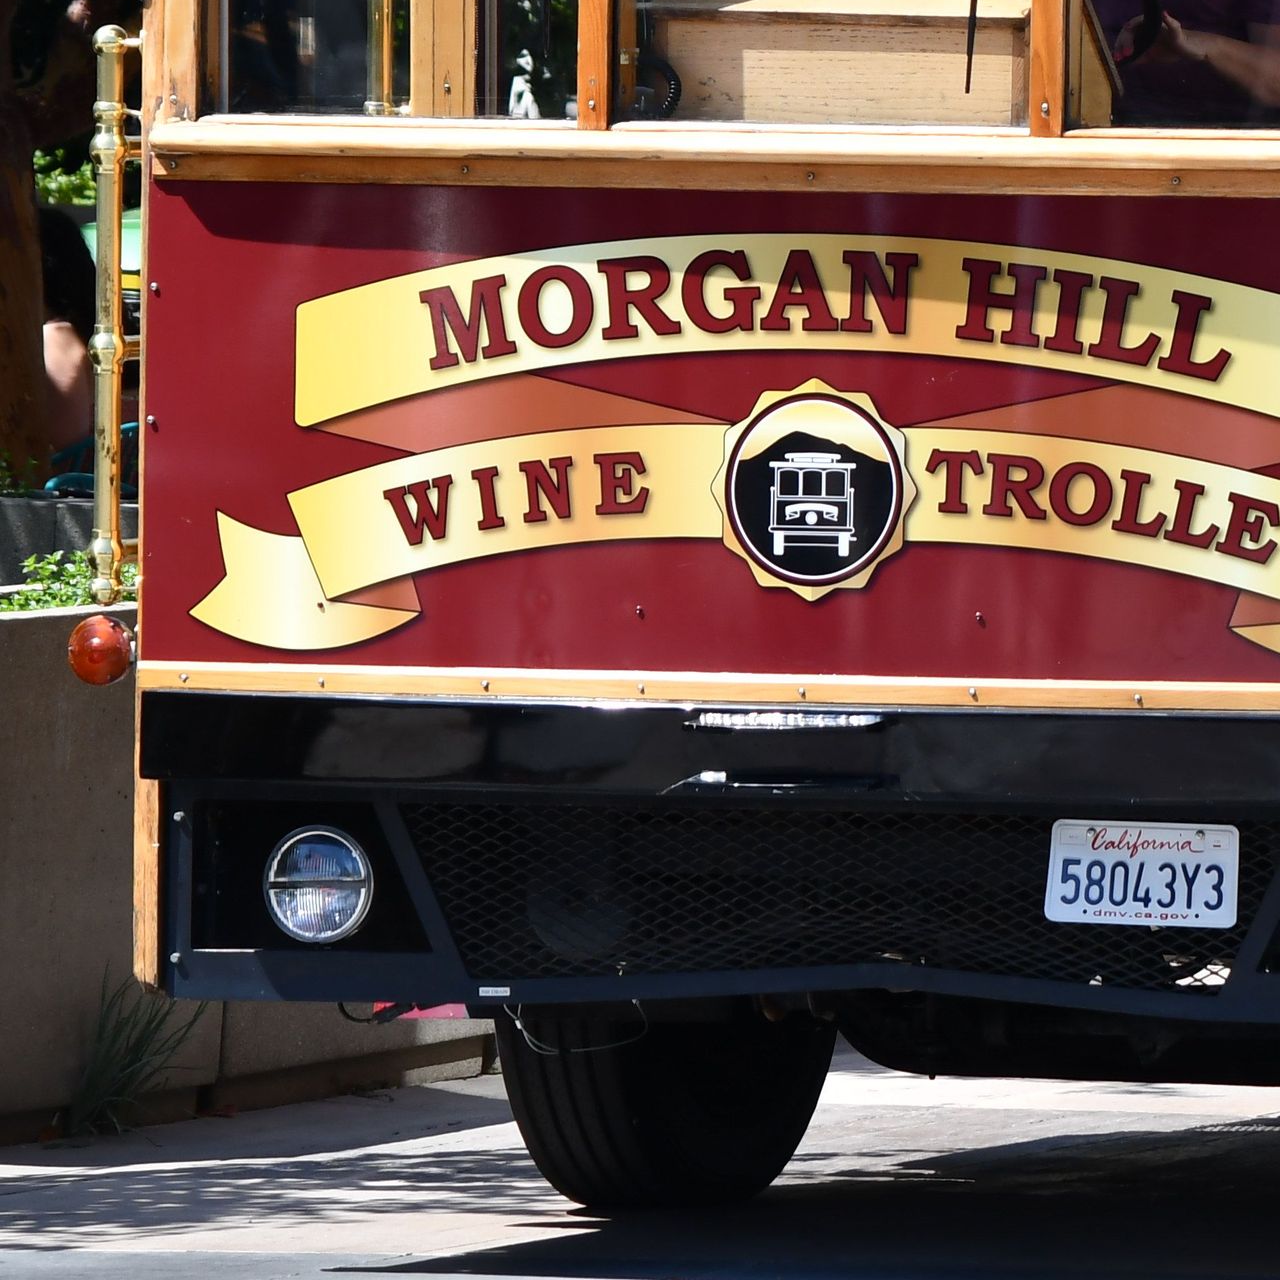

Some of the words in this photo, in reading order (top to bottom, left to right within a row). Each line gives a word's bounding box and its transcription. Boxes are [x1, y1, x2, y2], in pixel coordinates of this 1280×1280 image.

[418, 249, 917, 372] MORGAN
[953, 257, 1233, 384] HILL
[383, 451, 651, 548] WINE
[1091, 827, 1205, 859] California
[1060, 858, 1225, 911] 58043Y3
[1093, 909, 1189, 921] dmv.ca.gov
